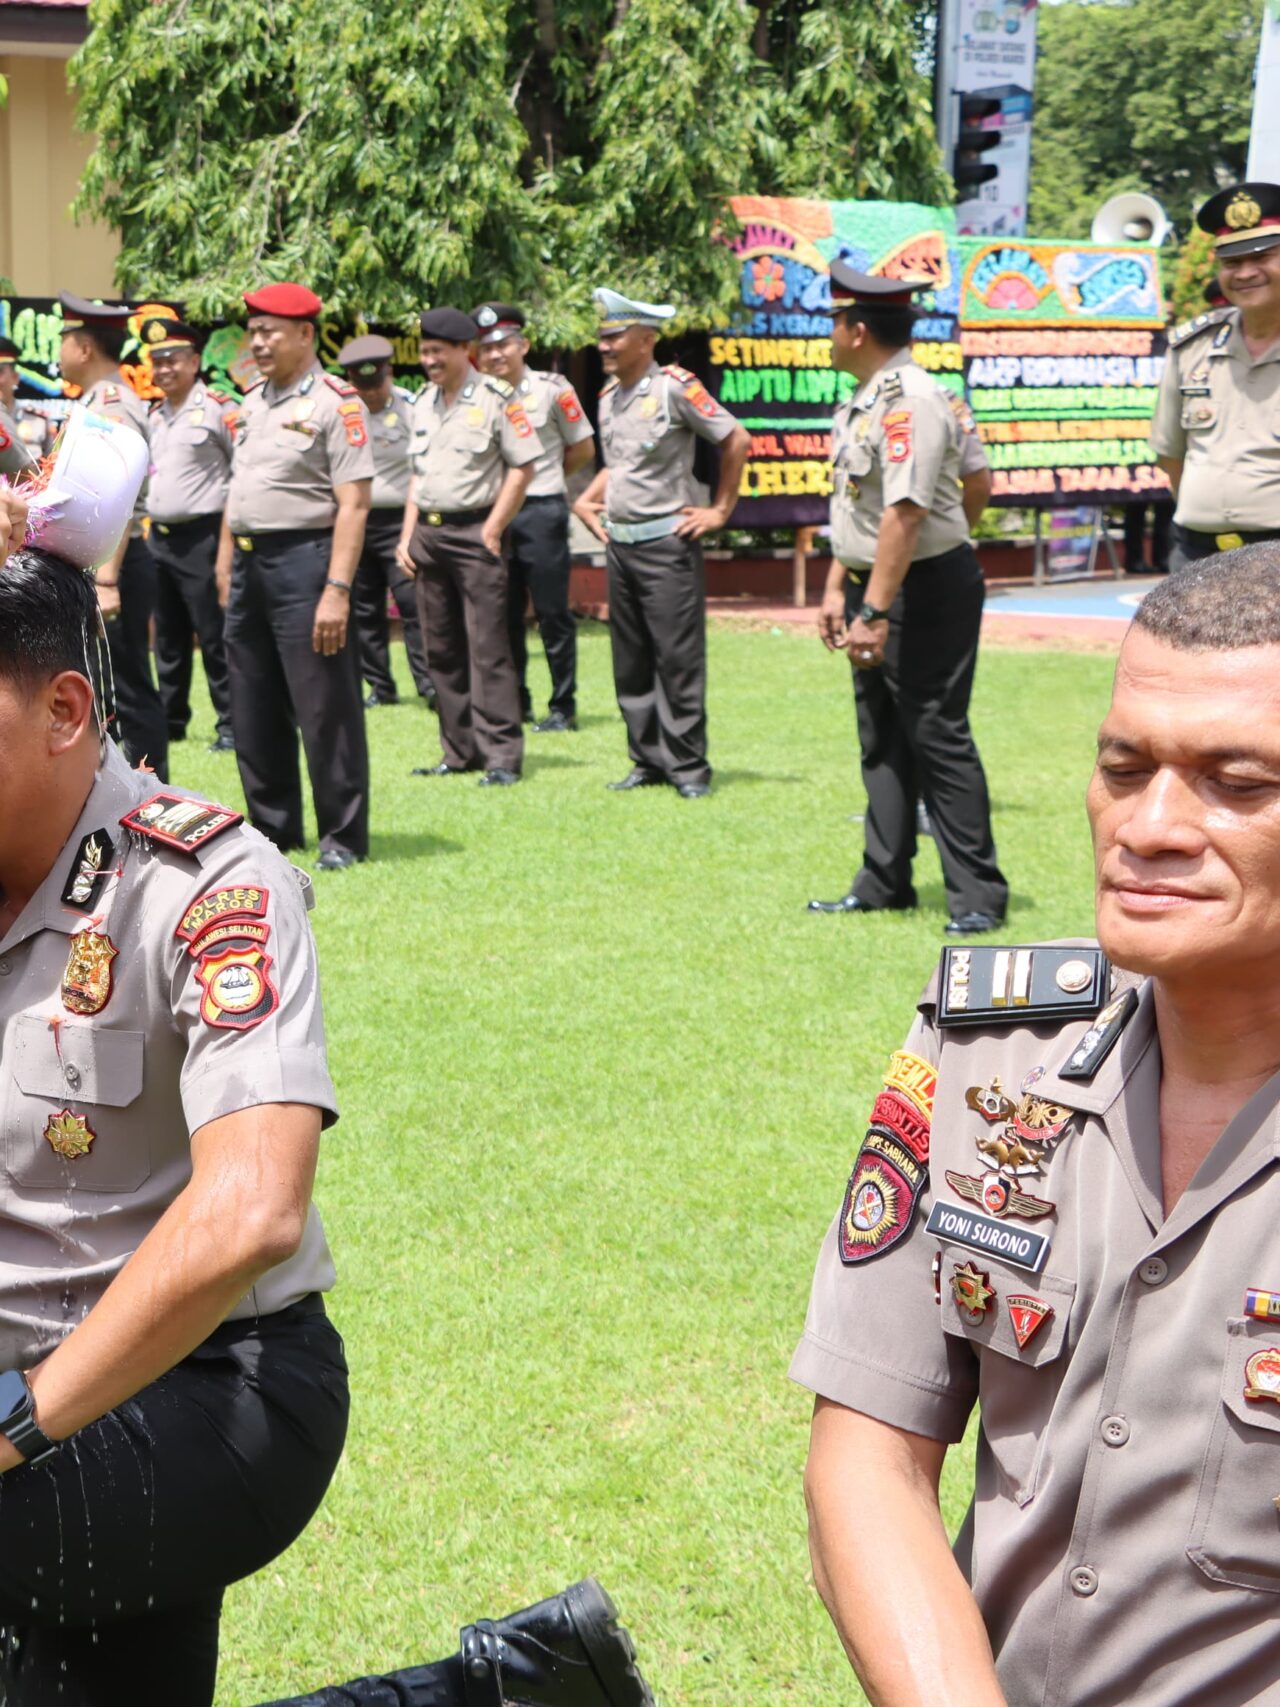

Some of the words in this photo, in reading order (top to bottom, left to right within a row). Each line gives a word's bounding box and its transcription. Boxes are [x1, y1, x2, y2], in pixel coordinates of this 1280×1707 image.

[182, 889, 260, 929] POLRES
[191, 899, 255, 930] MAROS
[229, 924, 264, 938] SELATAN
[882, 1141, 919, 1183] SABHARA
[938, 1211, 972, 1237] YONI
[971, 1223, 1031, 1257] SURONO
